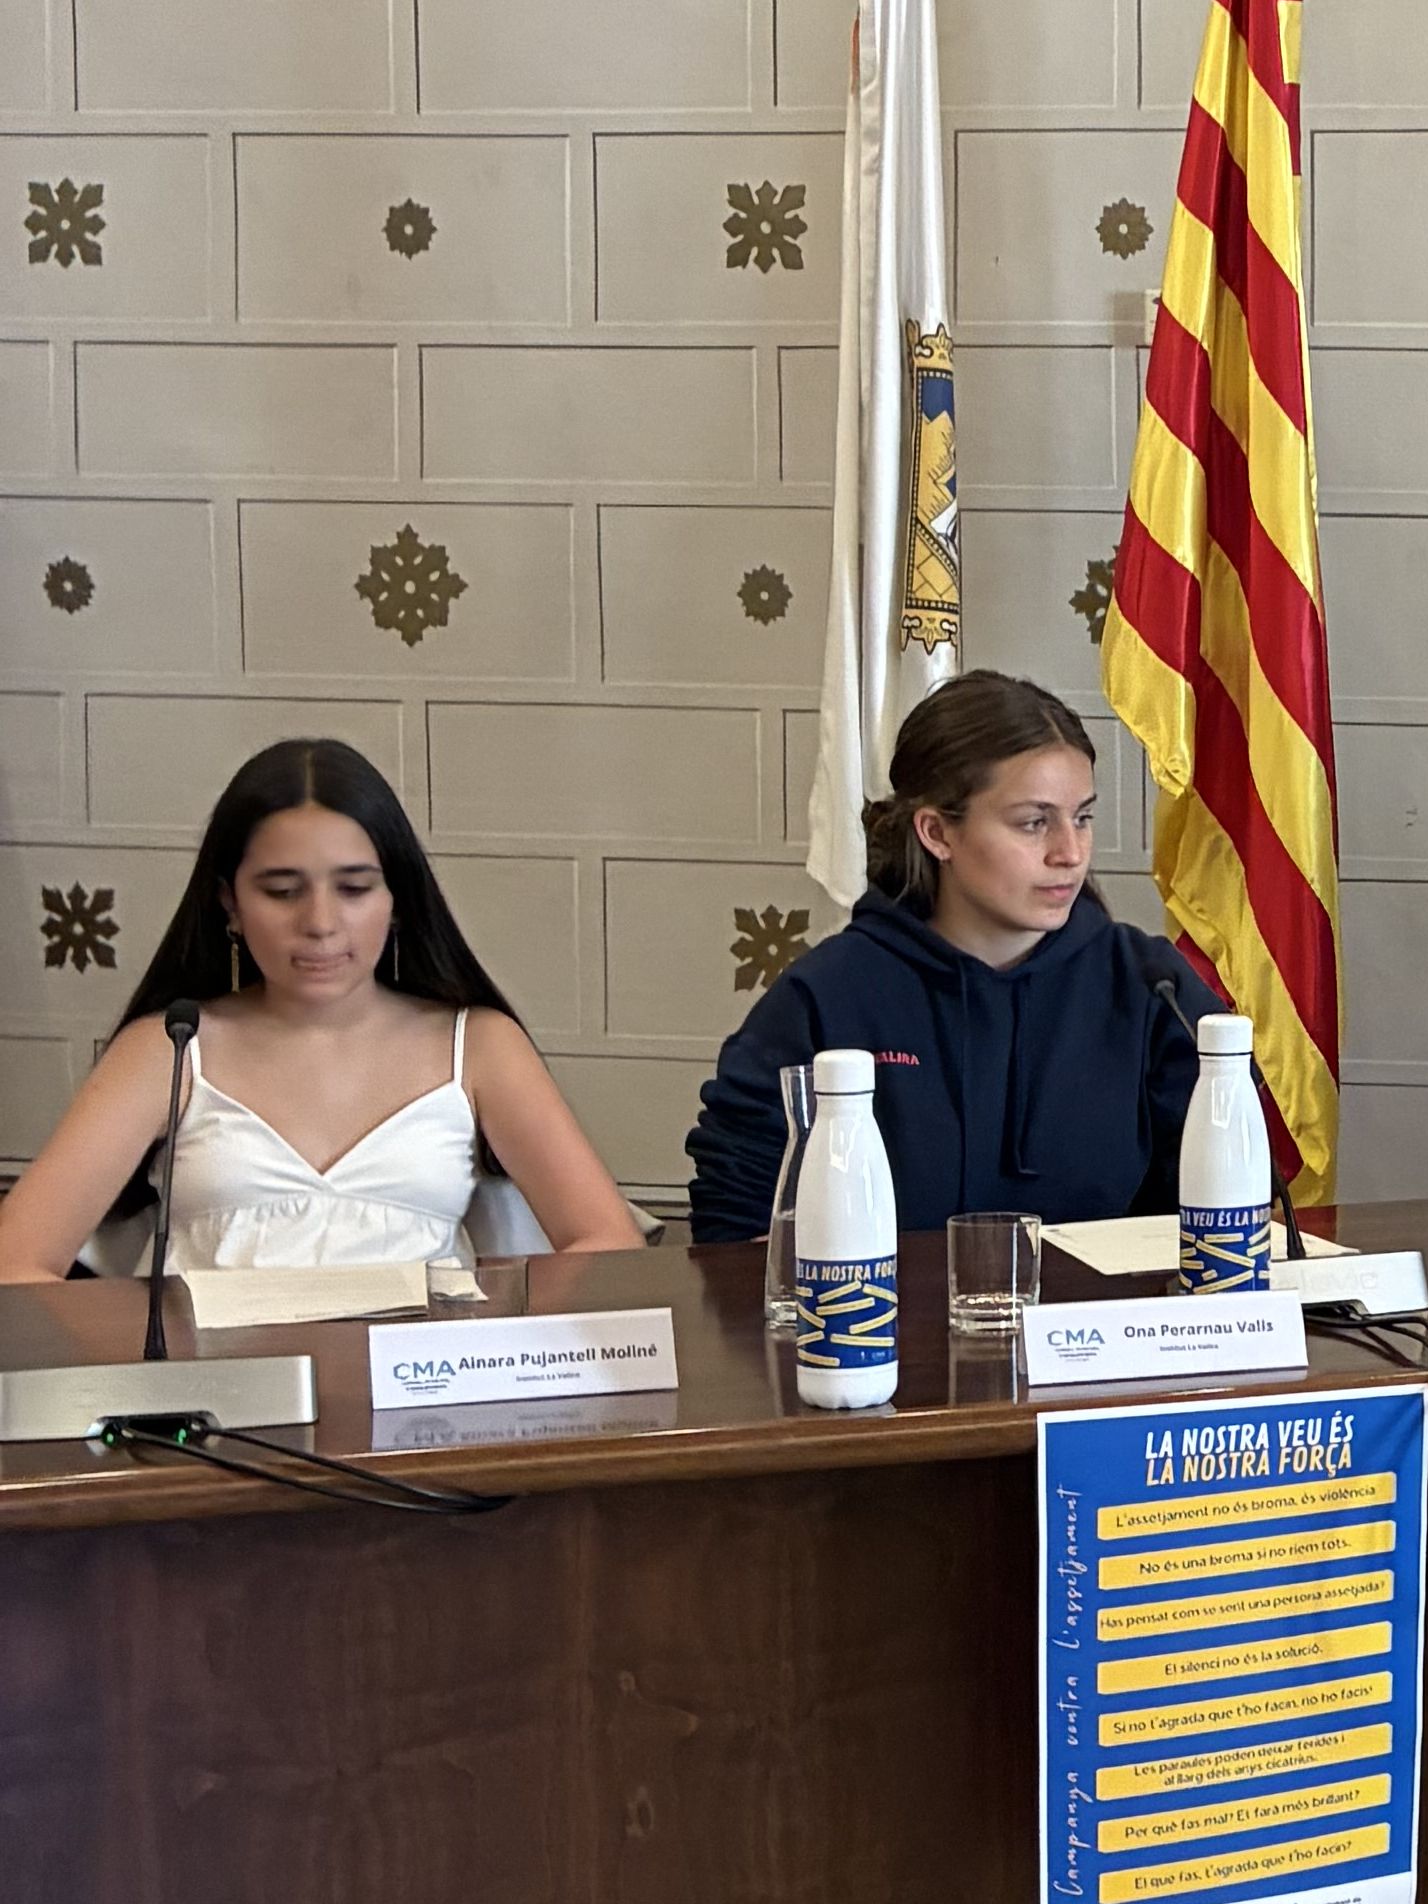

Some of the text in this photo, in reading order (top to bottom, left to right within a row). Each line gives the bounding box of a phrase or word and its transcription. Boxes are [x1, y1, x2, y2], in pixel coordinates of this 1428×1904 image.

[876, 1050, 920, 1066] ALIRA
[1193, 1211, 1214, 1227] VEU
[1234, 1211, 1249, 1226] LA
[805, 1264, 817, 1280] LA
[821, 1264, 871, 1281] NOSTRA
[1046, 1328, 1105, 1346] CMA
[1123, 1319, 1273, 1338] Ona Perarnau Valls
[458, 1343, 657, 1369] Ainara Pujantell Moliné
[392, 1359, 456, 1380] CMA
[1145, 1410, 1354, 1459] LA NOSTRA VEU ÉS
[1146, 1442, 1351, 1486] LA NOSTRA FORÇA
